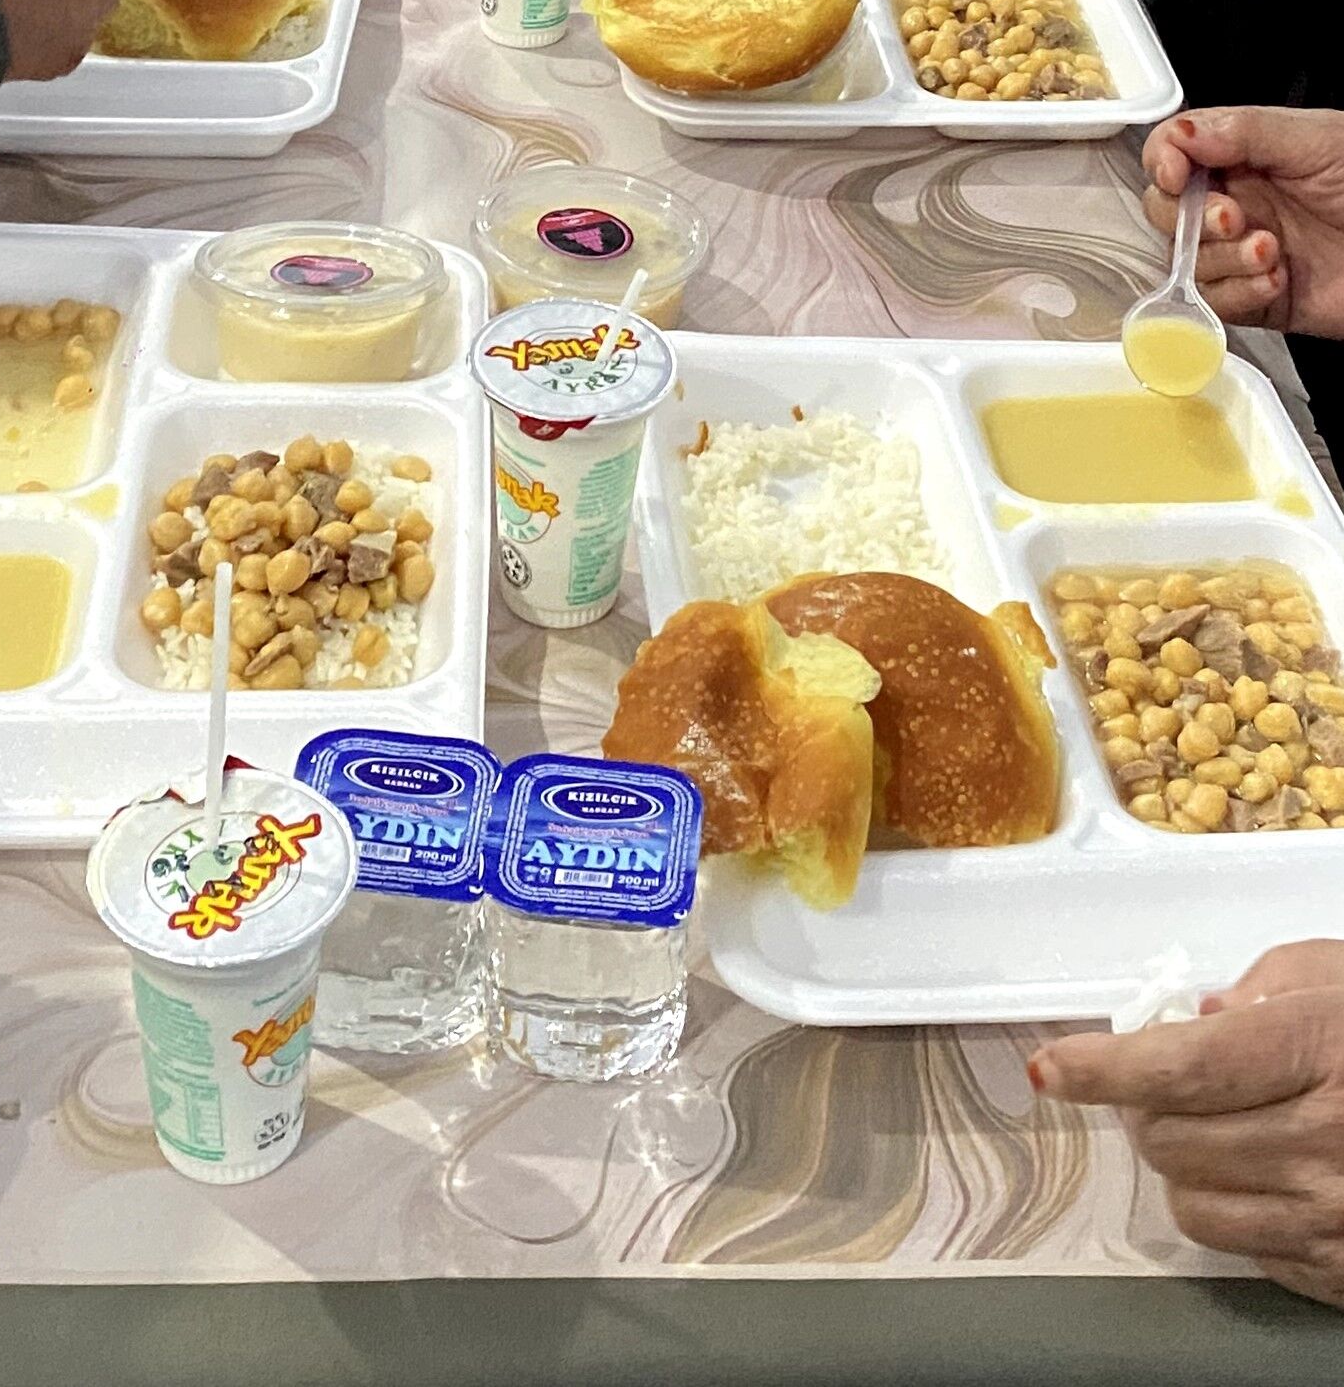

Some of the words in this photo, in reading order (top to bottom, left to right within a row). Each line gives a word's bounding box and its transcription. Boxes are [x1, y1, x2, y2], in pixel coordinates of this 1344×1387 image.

[370, 764, 440, 783] KIZILCIK
[567, 791, 638, 805] KIZILCIK
[355, 814, 464, 849] YDIN
[415, 849, 439, 860] 200
[441, 852, 456, 863] ml
[522, 839, 665, 872] AYDIN
[618, 874, 641, 886] 200
[643, 876, 659, 887] ml
